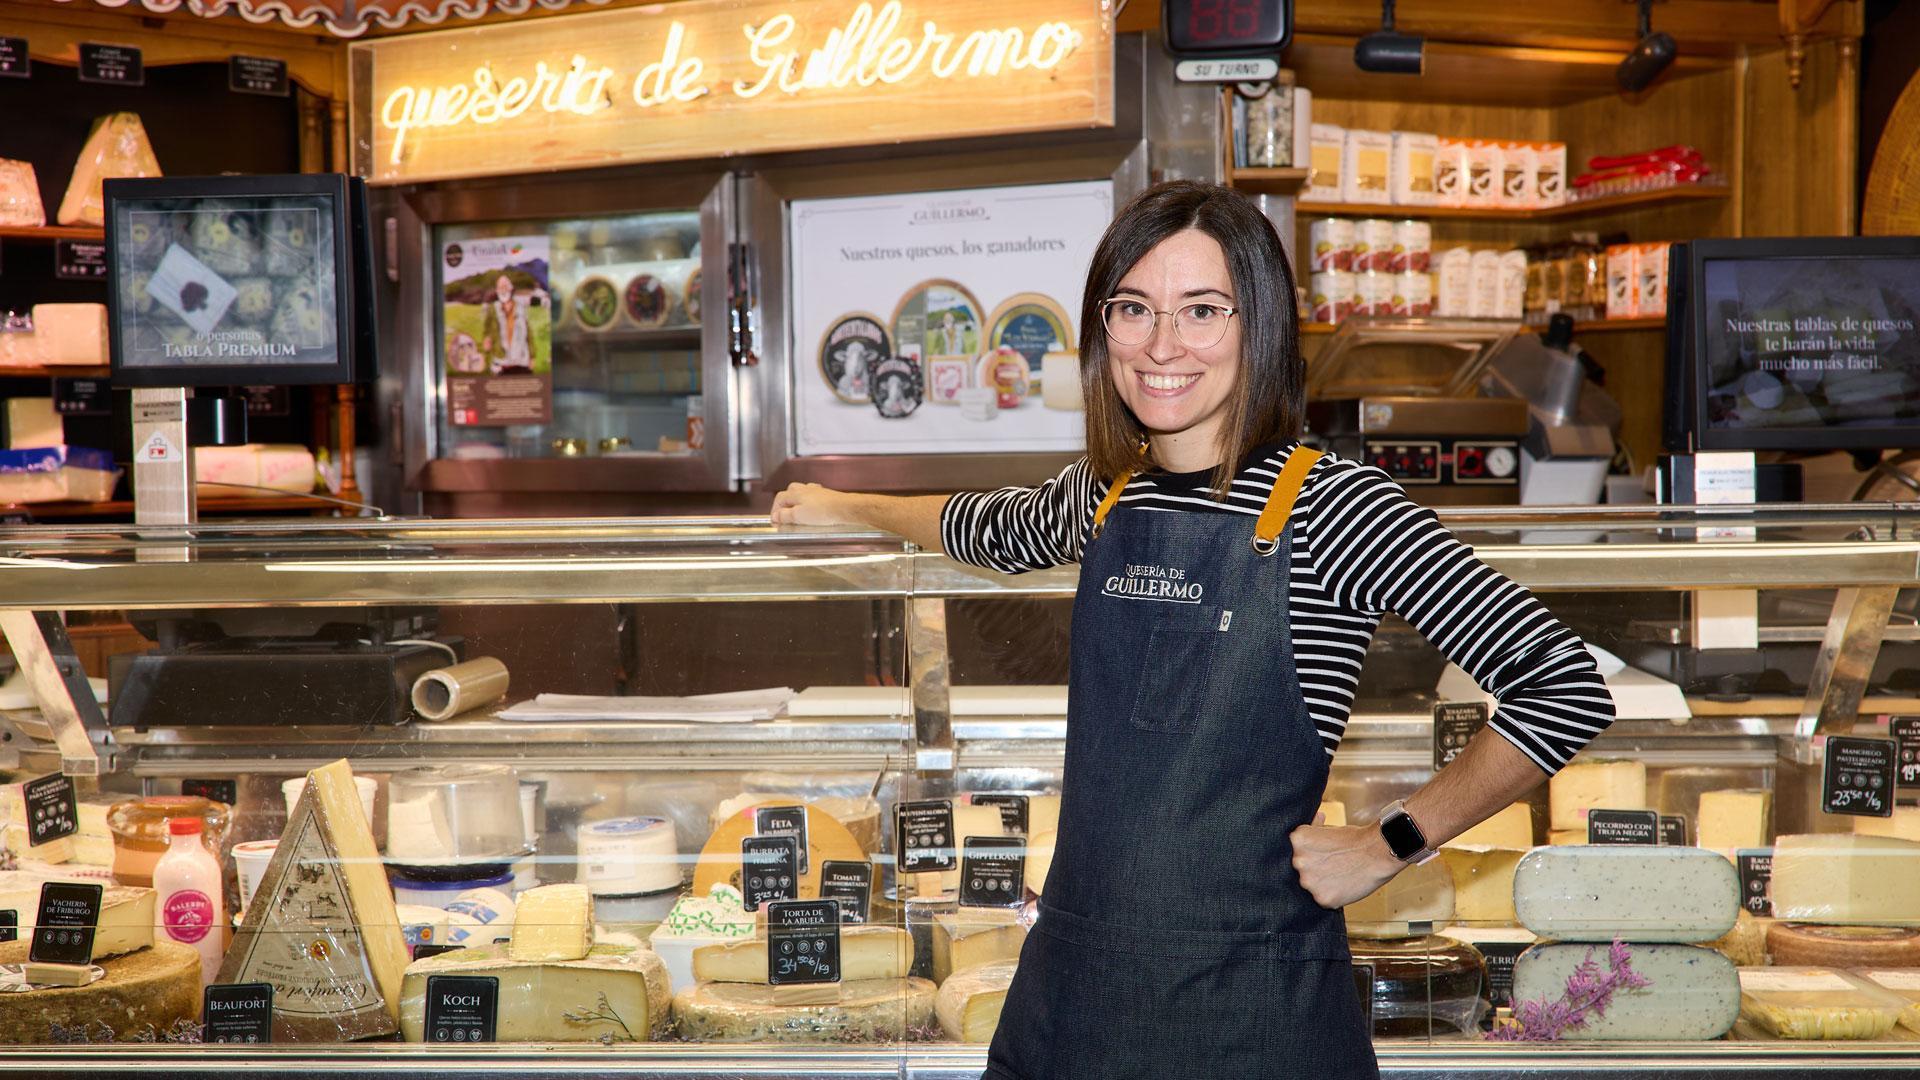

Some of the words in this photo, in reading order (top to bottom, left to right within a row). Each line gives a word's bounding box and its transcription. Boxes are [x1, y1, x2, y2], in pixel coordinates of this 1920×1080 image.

[633, 21, 710, 107] de
[733, 0, 1083, 98] Guillermo
[1194, 65, 1212, 76] SU
[1219, 63, 1260, 76] TURNO
[913, 207, 986, 222] GUILLERMO
[840, 245, 902, 263] Nuestros
[906, 242, 957, 262] quesos,
[962, 239, 984, 256] los
[986, 236, 1066, 256] ganadores
[1726, 317, 1791, 333] Nuestras
[1794, 316, 1838, 332] tablas
[1841, 317, 1861, 332] de
[1863, 318, 1914, 334] quesos
[206, 330, 263, 343] personas
[1765, 337, 1780, 351] te
[1783, 335, 1826, 351] harán
[1828, 335, 1841, 350] la
[1844, 334, 1876, 350] vida
[162, 343, 213, 358] TABLA
[218, 342, 297, 357] PREMIUM
[1759, 354, 1811, 371] mucho
[1813, 353, 1844, 370] más
[1847, 352, 1883, 370] fácil.
[1126, 563, 1166, 578] QUESERÍA
[1169, 567, 1186, 580] DE
[1105, 576, 1203, 599] GUILLERMO
[1841, 748, 1882, 757] MANCHEGO
[1836, 755, 1886, 766] PASTEURIZADO
[771, 819, 792, 829] FETA
[1594, 821, 1633, 830] PECORINO
[1634, 822, 1652, 831] CON
[1622, 829, 1649, 837] NEGRA
[750, 847, 790, 857] BURRATA
[832, 873, 861, 881] TOMATE
[52, 899, 88, 908] VACHERIN
[46, 906, 56, 914] DE
[57, 906, 91, 915] FRIBURGO
[783, 909, 811, 918] TORTA
[812, 908, 824, 916] DE
[782, 918, 793, 926] LA
[794, 917, 825, 926] ABUELA
[210, 1000, 268, 1011] BEAUFORT
[443, 994, 480, 1006] KOCH
